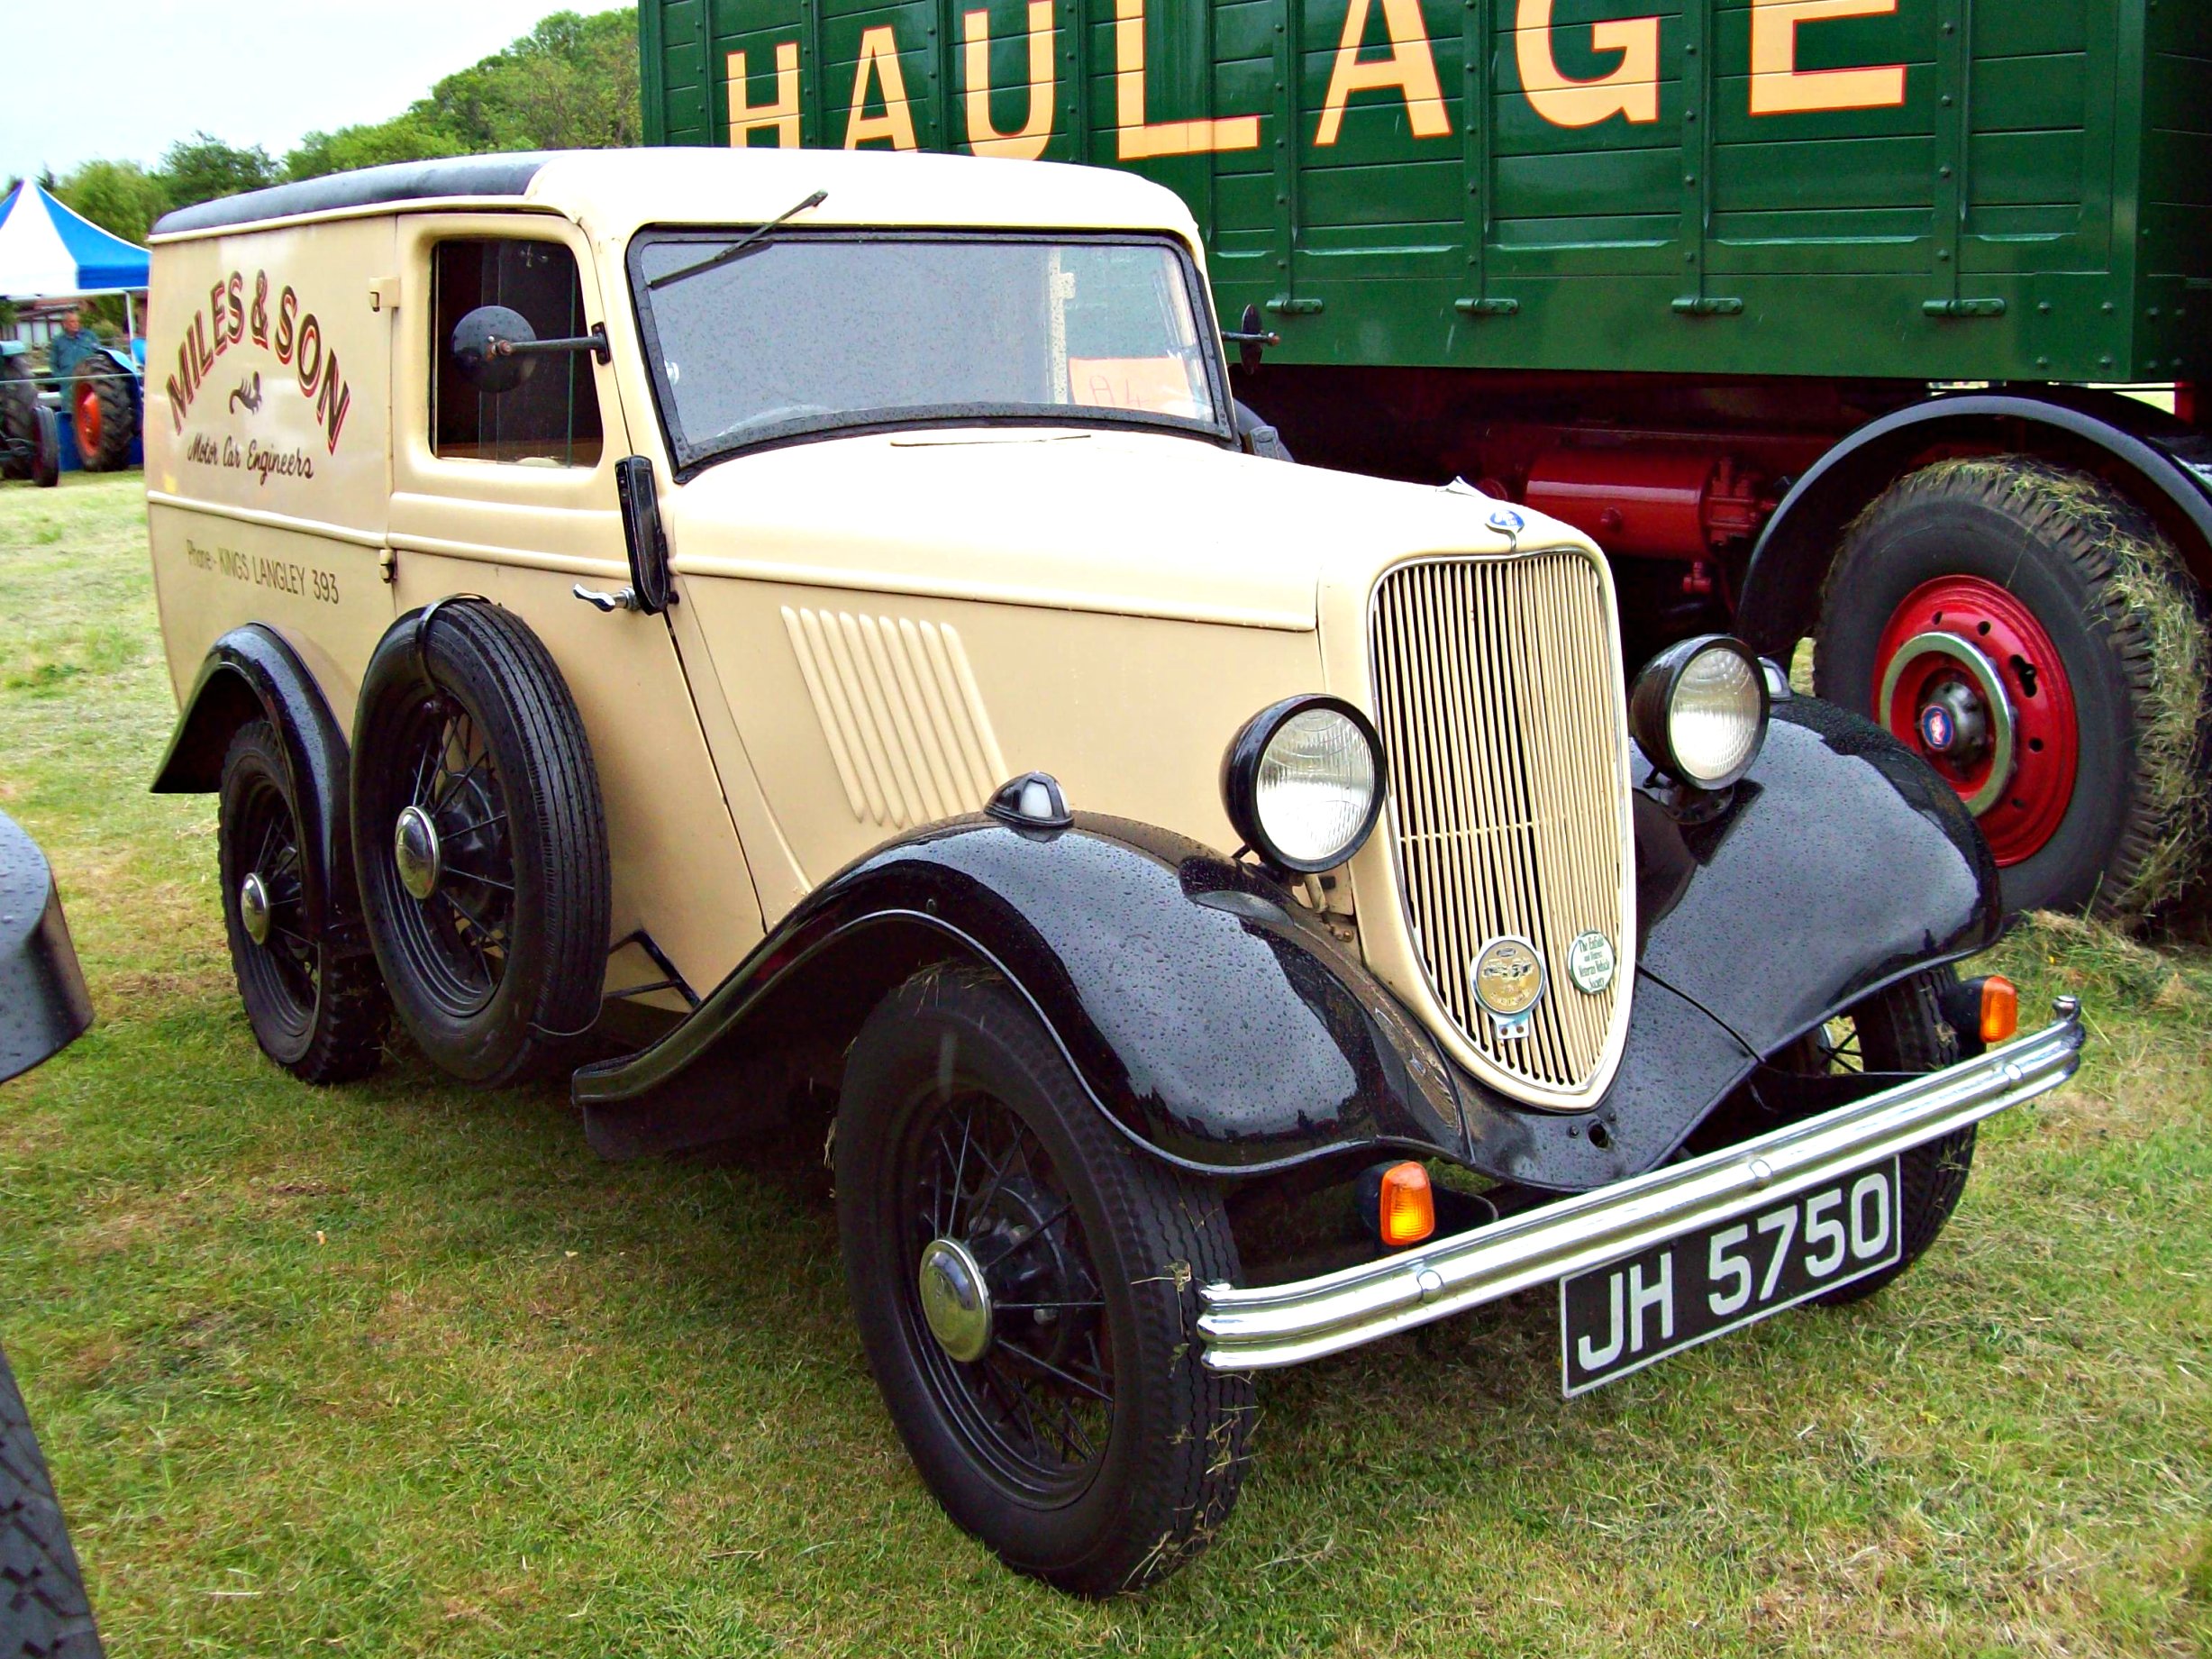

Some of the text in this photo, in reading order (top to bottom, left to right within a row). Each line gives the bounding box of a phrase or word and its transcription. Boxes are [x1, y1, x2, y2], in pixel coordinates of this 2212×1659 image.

[726, 0, 1907, 160] HAULAGE
[166, 269, 350, 455] MILES & SON
[187, 433, 314, 488] Motor Car Engineers
[218, 547, 250, 581] KINGS
[252, 555, 305, 596] LANGLEY
[312, 570, 339, 605] 393
[1578, 1172, 1889, 1371] JH 5750
